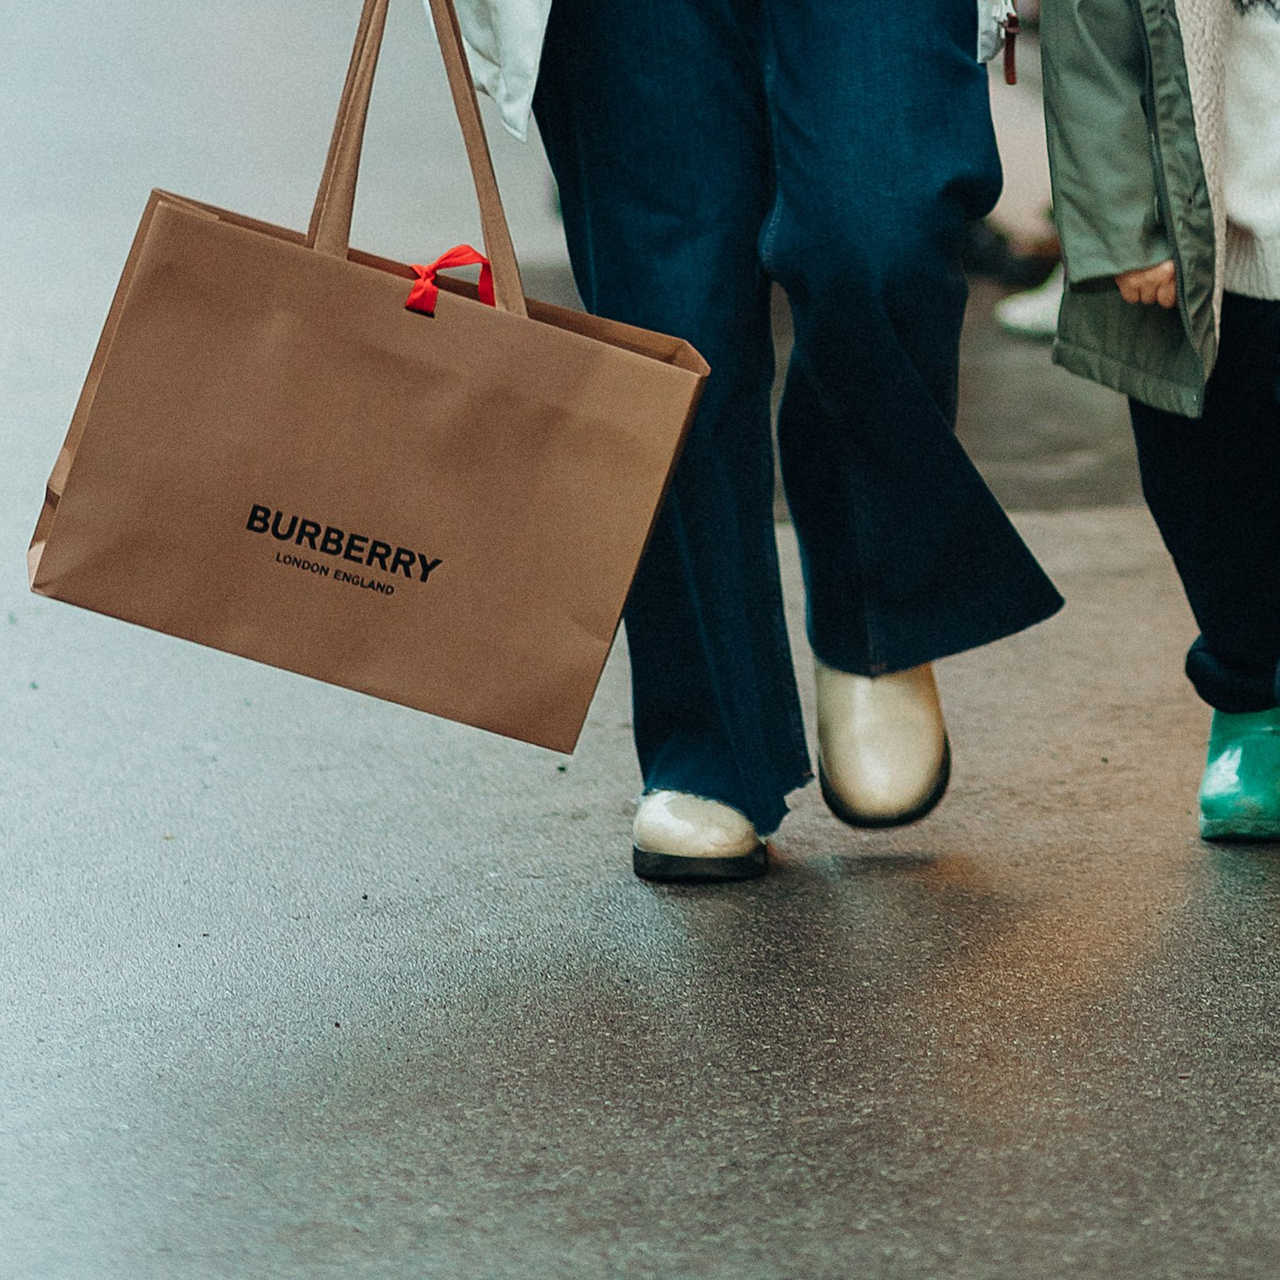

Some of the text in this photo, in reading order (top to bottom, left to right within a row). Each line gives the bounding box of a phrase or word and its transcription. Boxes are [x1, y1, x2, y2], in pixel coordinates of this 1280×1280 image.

[246, 503, 443, 584] BURBERRY
[275, 552, 395, 596] LONDON ENGLAND
